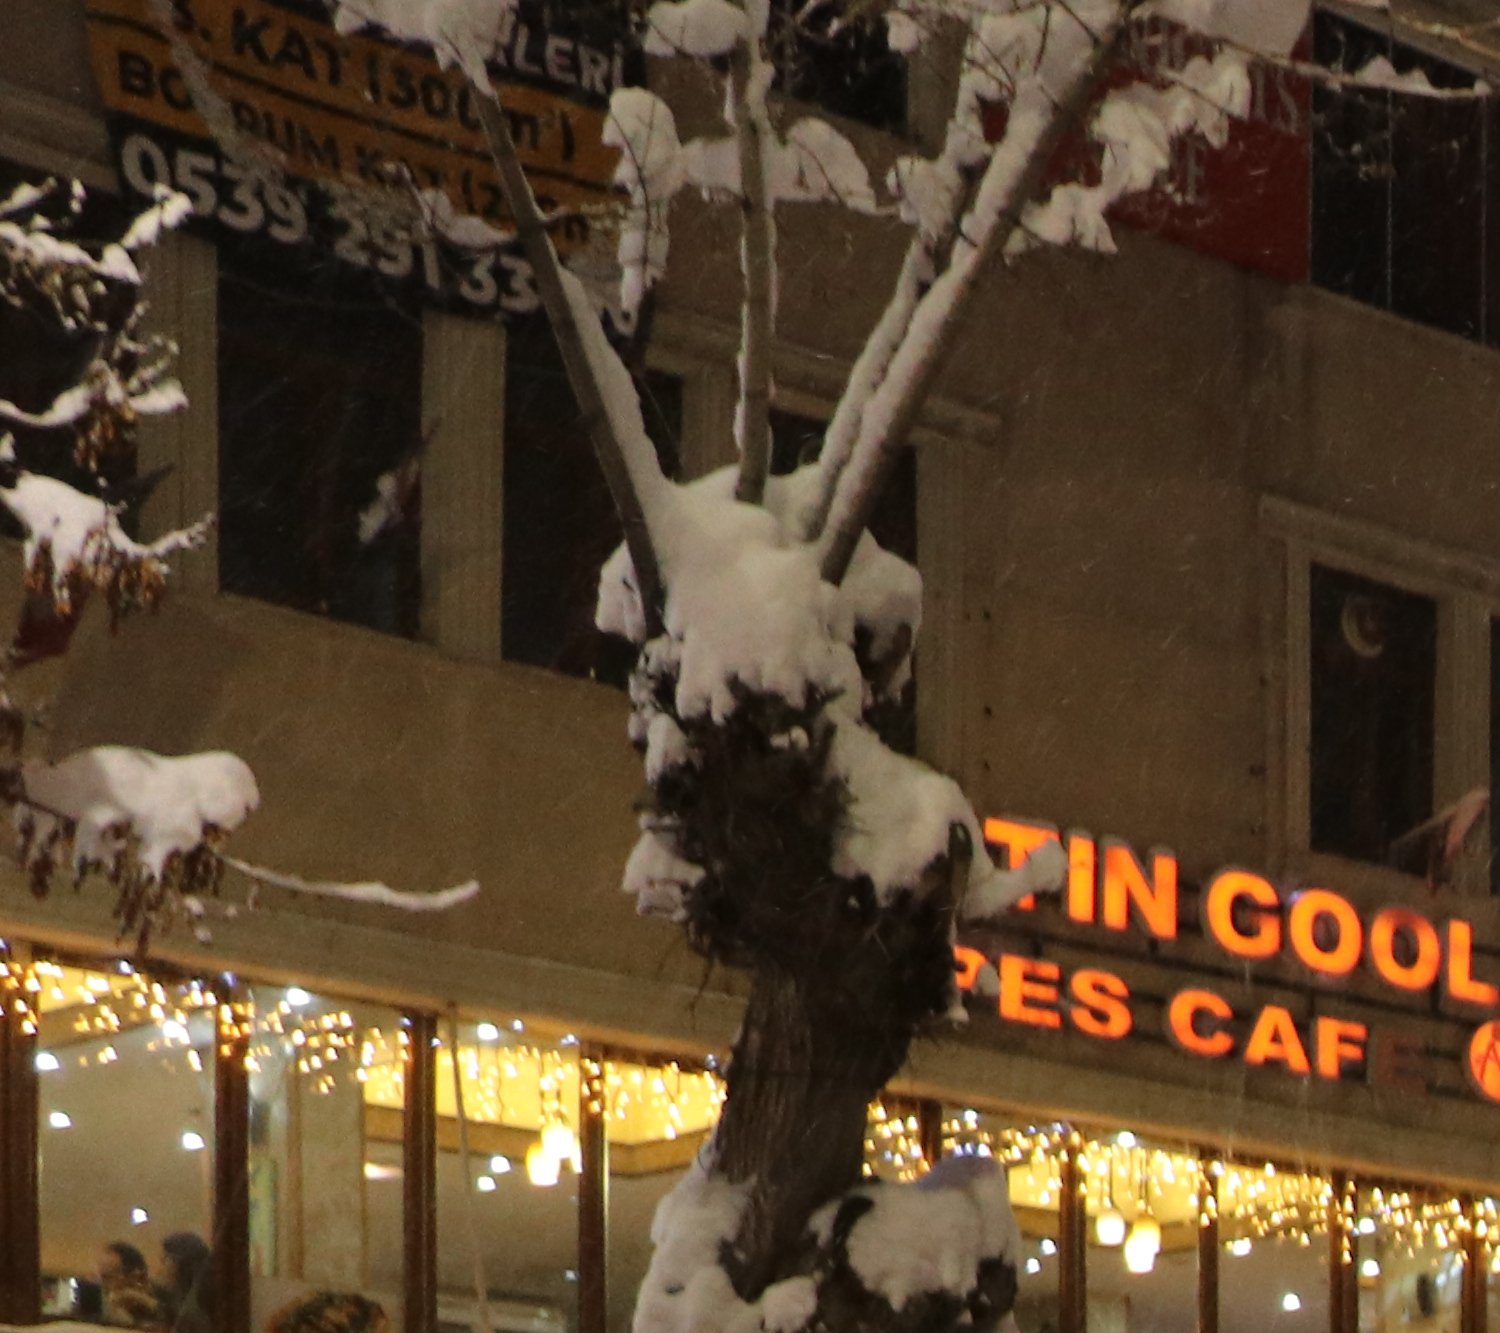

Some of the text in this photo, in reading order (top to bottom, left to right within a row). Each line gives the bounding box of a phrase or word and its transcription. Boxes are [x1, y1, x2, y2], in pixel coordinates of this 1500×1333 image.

[232, 8, 344, 86] KAT
[118, 50, 342, 178] BORUM
[1207, 869, 1500, 1005] GOOL
